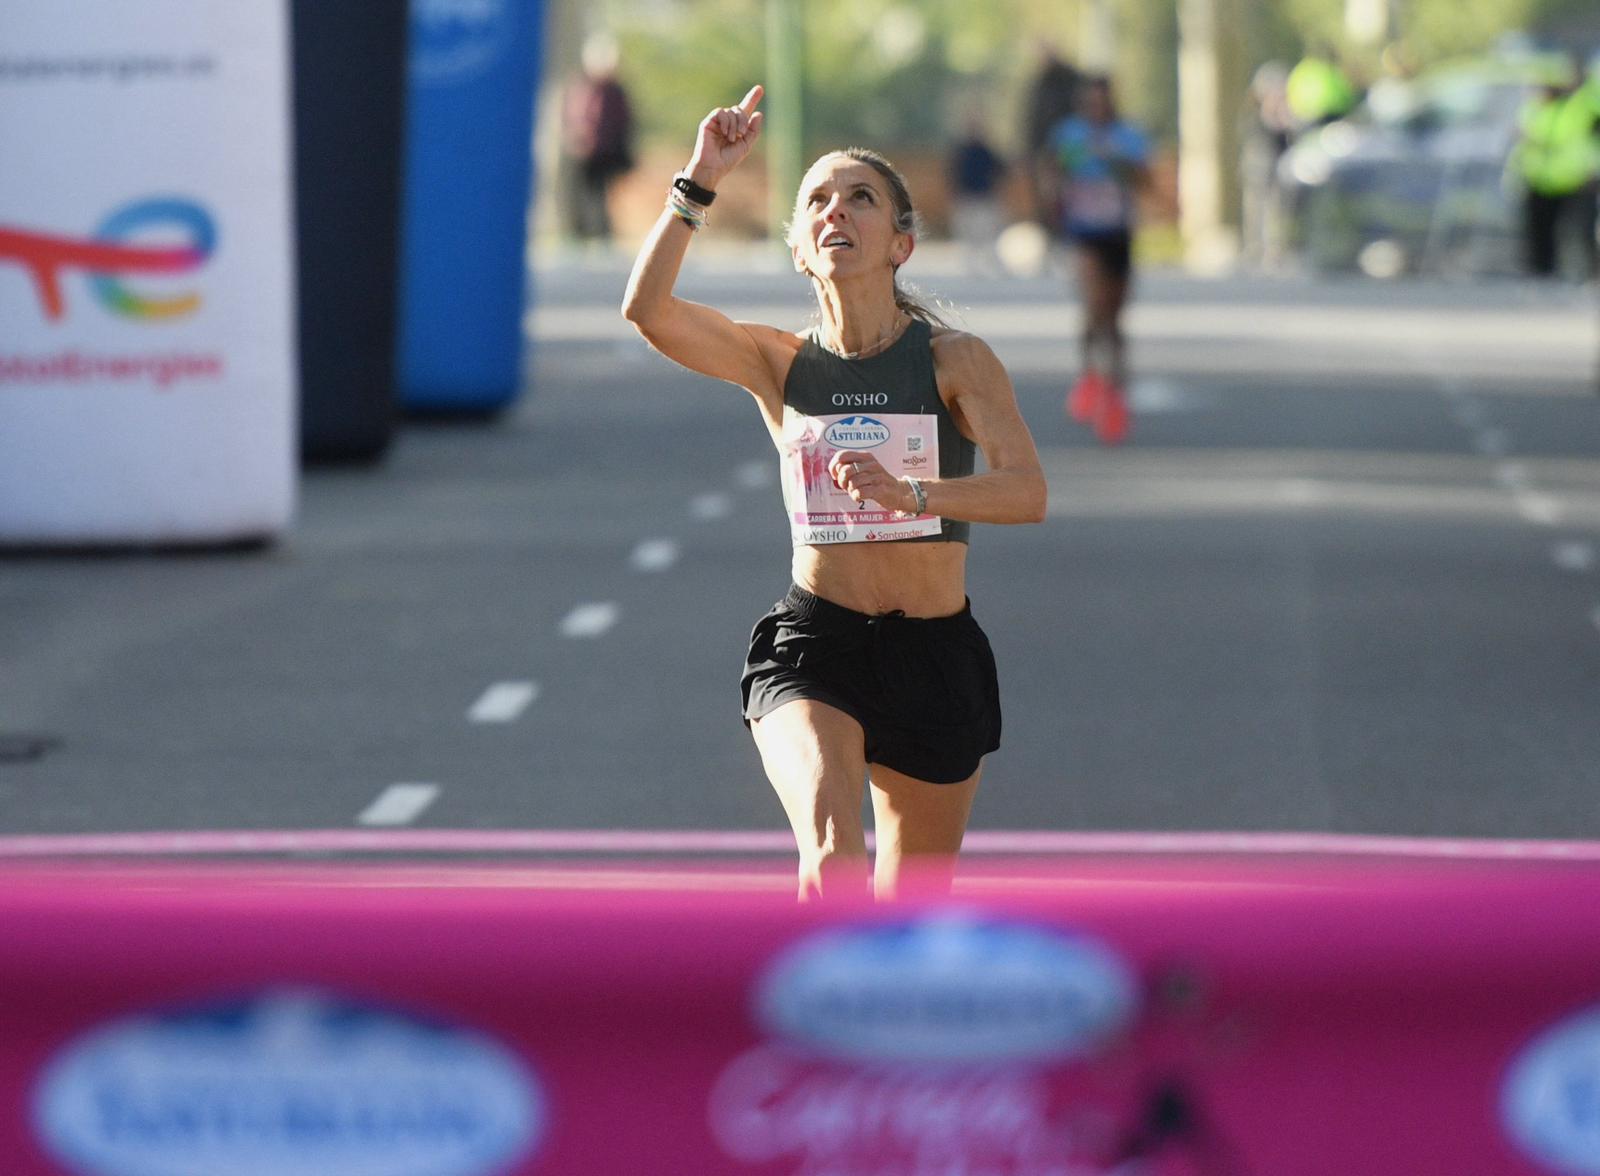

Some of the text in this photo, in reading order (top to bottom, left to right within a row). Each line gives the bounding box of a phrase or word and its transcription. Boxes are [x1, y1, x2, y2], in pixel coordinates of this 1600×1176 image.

[831, 392, 888, 406] OYSHO
[859, 500, 865, 510] 2
[807, 514, 836, 523] CARRERA
[859, 513, 884, 522] MUJER
[804, 530, 847, 542] OYSHO
[878, 530, 923, 540] Santander
